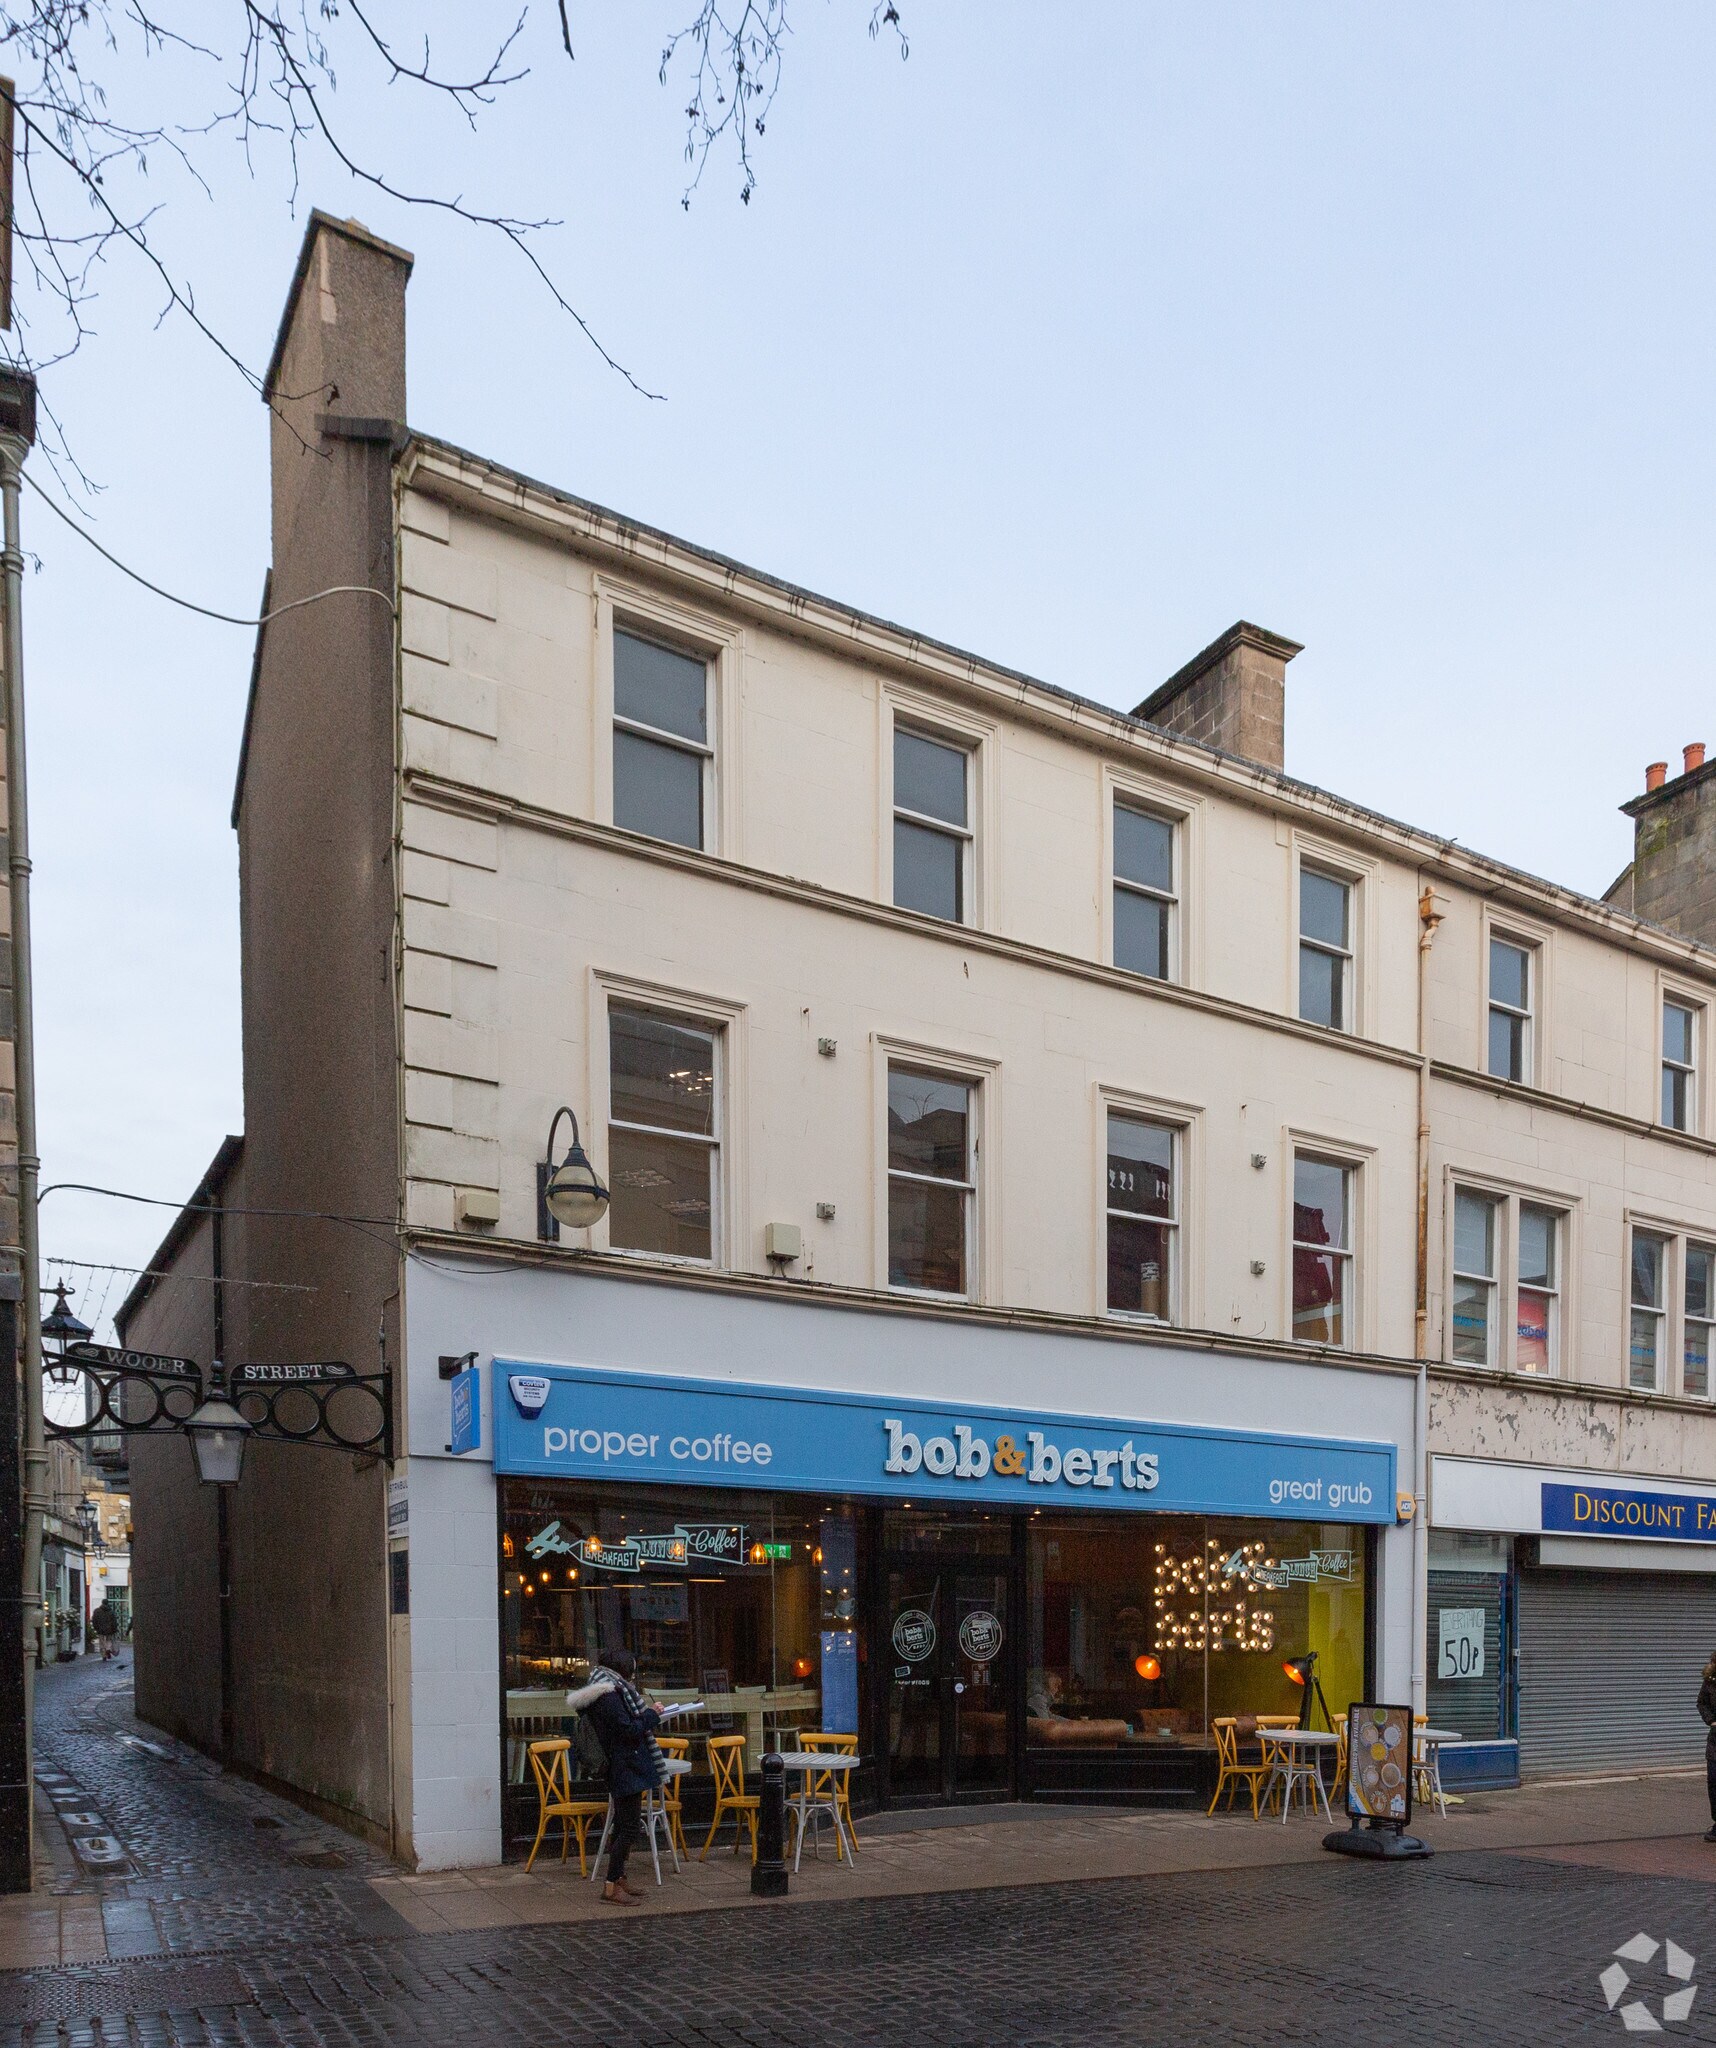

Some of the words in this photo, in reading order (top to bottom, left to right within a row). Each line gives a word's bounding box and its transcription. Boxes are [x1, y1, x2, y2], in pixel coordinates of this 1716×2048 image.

[106, 1349, 186, 1374] WOOER
[244, 1364, 322, 1379] STREET
[544, 1427, 659, 1461] proper
[669, 1433, 773, 1465] coffee
[1269, 1478, 1322, 1504] great
[1328, 1481, 1372, 1508] grub
[1574, 1493, 1685, 1528] DISCOUNT
[687, 1529, 737, 1553] Coffee
[585, 1548, 635, 1567] BREAKFAST
[1289, 1561, 1316, 1578] LUNCH
[1318, 1554, 1348, 1573] Coffee
[1256, 1567, 1286, 1584] BREAKFAST
